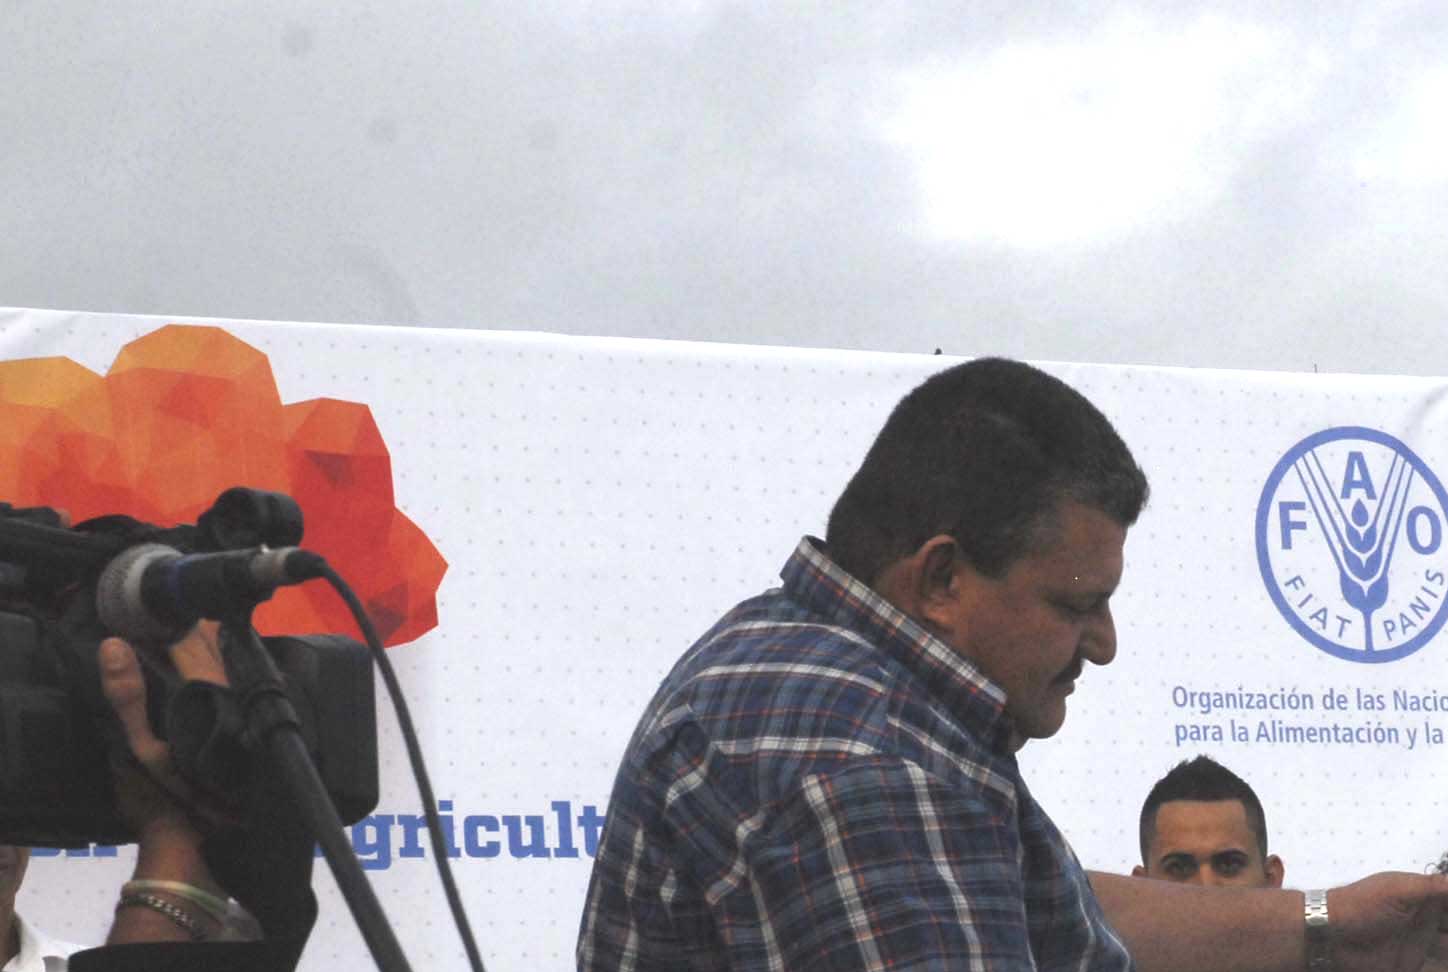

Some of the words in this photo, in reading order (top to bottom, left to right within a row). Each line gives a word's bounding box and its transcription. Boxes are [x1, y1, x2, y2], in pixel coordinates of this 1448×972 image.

[1278, 451, 1443, 555] FAO
[1284, 575, 1353, 639] FIAT
[1383, 569, 1445, 642] PANIS
[1172, 685, 1314, 714] Organización
[1322, 687, 1349, 711] de
[1356, 687, 1386, 711] las
[1175, 723, 1224, 747] para
[1231, 719, 1249, 742] la
[1255, 720, 1399, 744] Alimentación
[1406, 727, 1417, 750] y
[1425, 722, 1444, 744] la
[315, 799, 608, 870] gricult
